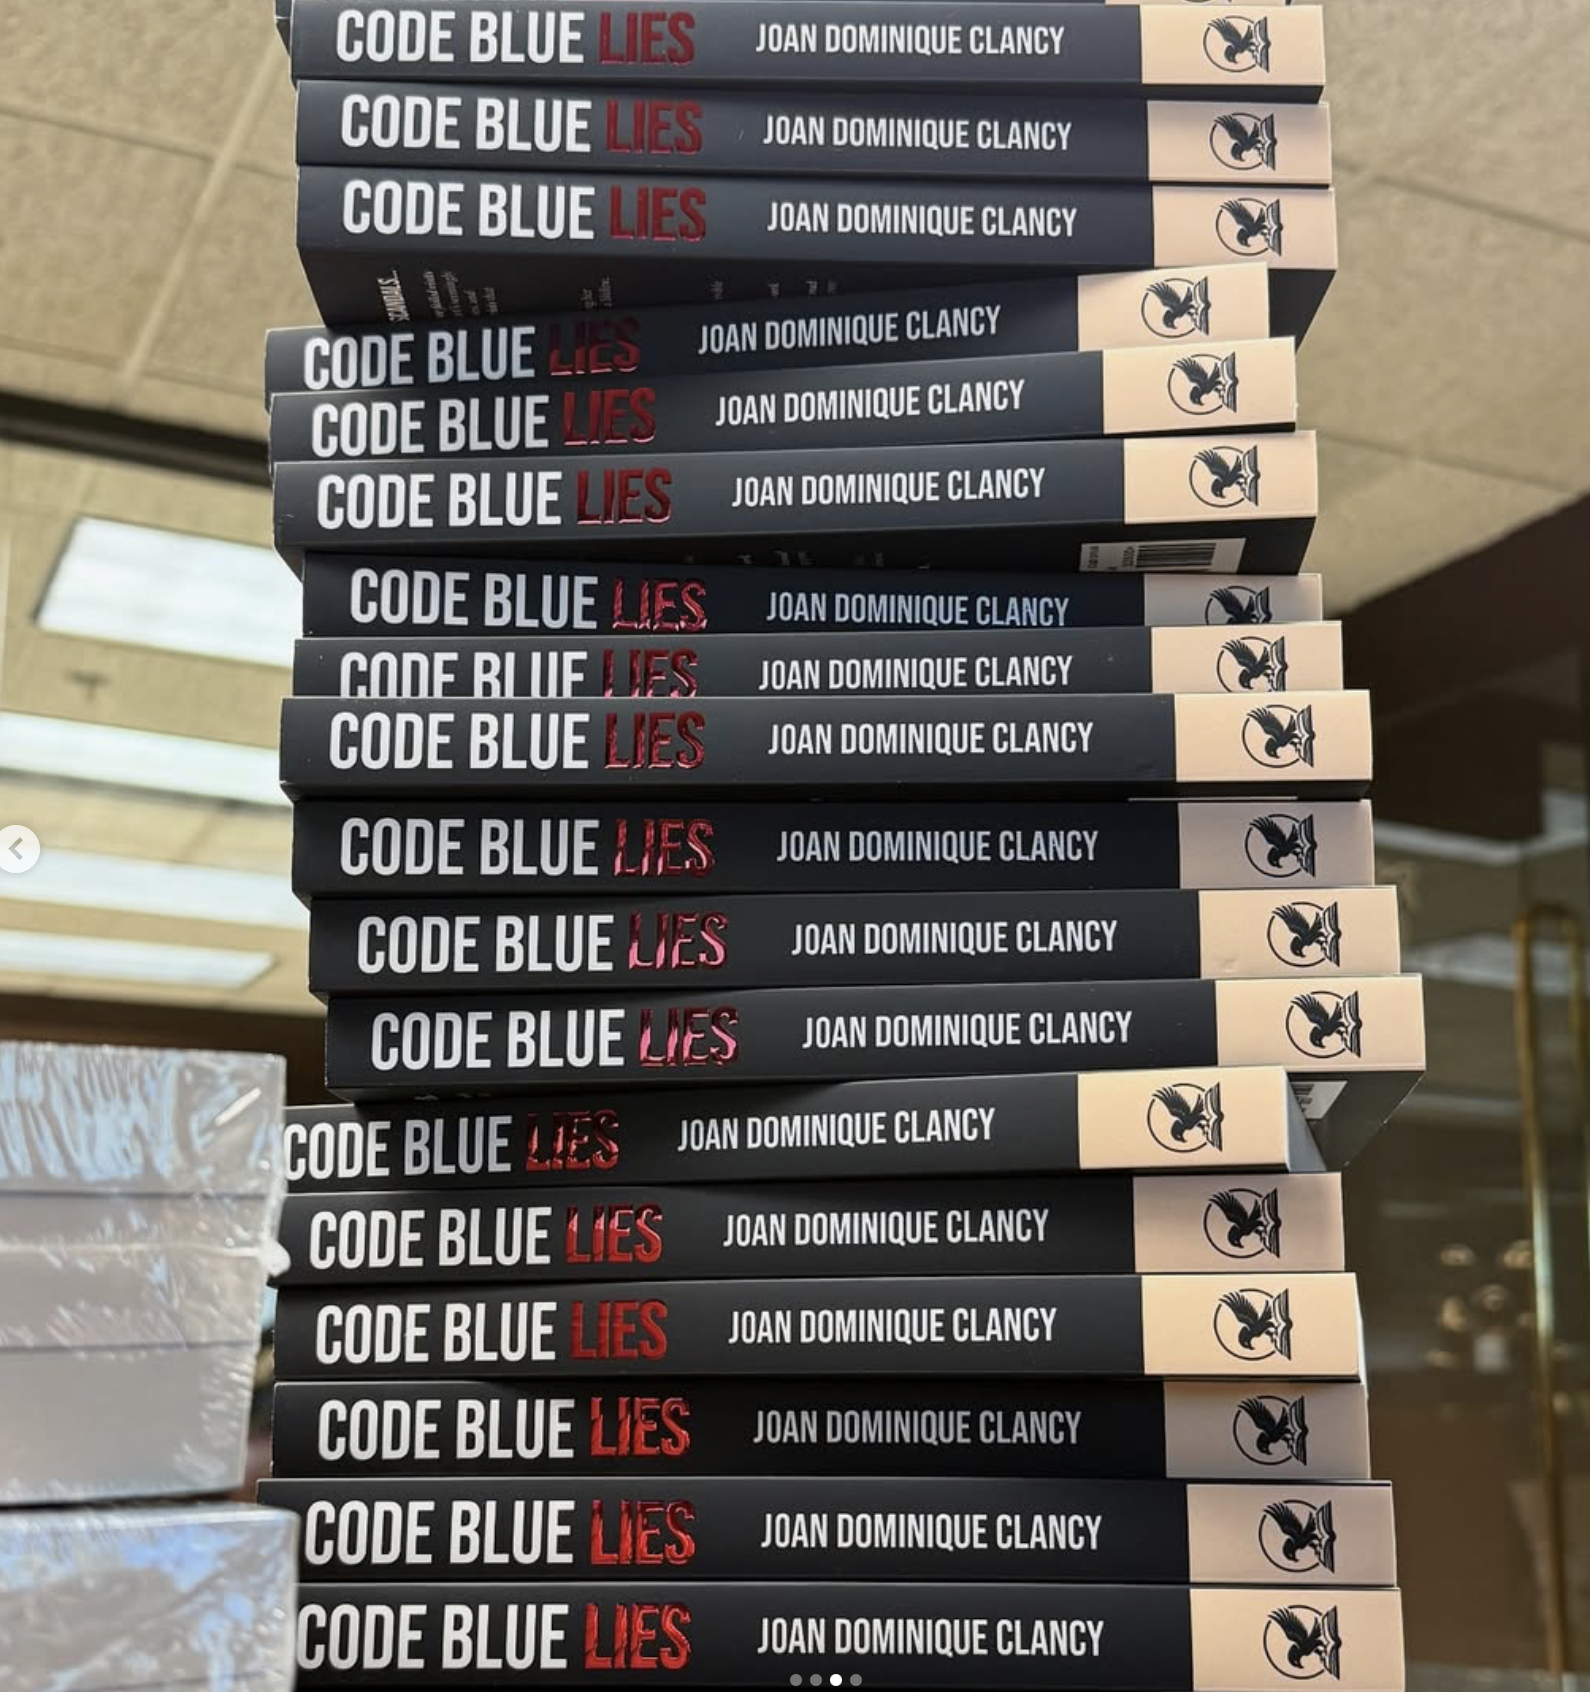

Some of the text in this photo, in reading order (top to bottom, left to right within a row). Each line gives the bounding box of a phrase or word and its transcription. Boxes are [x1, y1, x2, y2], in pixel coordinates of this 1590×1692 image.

[336, 8, 696, 66] CODE BLUE LIES
[755, 23, 1064, 55] JOAN DOMINIQUE CLANCY
[341, 93, 703, 156] CODE BLUE LIES
[763, 115, 1071, 150] JOAN DOMINIQUE CLANCY
[343, 179, 707, 244] CODE BLUE LIES
[767, 201, 1076, 236] JOAN DOMINIQUE CLANCY
[302, 316, 643, 390] CODE BLUE LIES
[698, 304, 1000, 354] JOAN DOMINIQUE CLANCY
[311, 387, 657, 457] CODE BLUE LIES
[715, 379, 1024, 426] JOAN DOMINIQUE CLANCY
[317, 466, 673, 529] CODE BLUE LIES
[731, 467, 1045, 507] JOAN DOMINIQUE CLANCY
[350, 568, 707, 633] CODE BLUE LIES
[766, 591, 1069, 626] JOAN DOMINIQUE CLANCY
[339, 650, 461, 698] CODE
[601, 647, 701, 700] LIES
[758, 655, 1072, 690] JOAN DOMINIQUE CLANCY
[329, 711, 707, 770] CODE BLUE LIES
[768, 721, 1093, 755] JOAN DOMINIQUE CLANCY
[340, 817, 715, 878] CODE BLUE LIES
[776, 829, 1097, 863] JOAN DOMINIQUE CLANCY
[357, 912, 730, 973] CODE BLUE LIES
[791, 919, 1117, 955] JOAN DOMINIQUE CLANCY
[371, 1006, 739, 1070] CODE BLUE LIES
[802, 1010, 1132, 1048] JOAN DOMINIQUE CLANCY
[282, 1109, 621, 1177] CODE BLUE LIES
[677, 1107, 995, 1151] JOAN DOMINIQUE CLANCY
[309, 1202, 665, 1269] CODE BLUE LIES
[723, 1208, 1048, 1246] JOAN DOMINIQUE CLANCY
[316, 1299, 670, 1364] CODE BLUE LIES
[728, 1306, 1056, 1344] JOAN DOMINIQUE CLANCY
[318, 1395, 693, 1460] CODE BLUE LIES
[753, 1409, 1081, 1445] JOAN DOMINIQUE CLANCY
[305, 1498, 698, 1568] CODE BLUE LIES
[760, 1512, 1101, 1551] JOAN DOMINIQUE CLANCY
[297, 1603, 693, 1673] CODE BLUE LIES
[757, 1617, 1103, 1657] JOAN DOMINIQUE CLANCY
